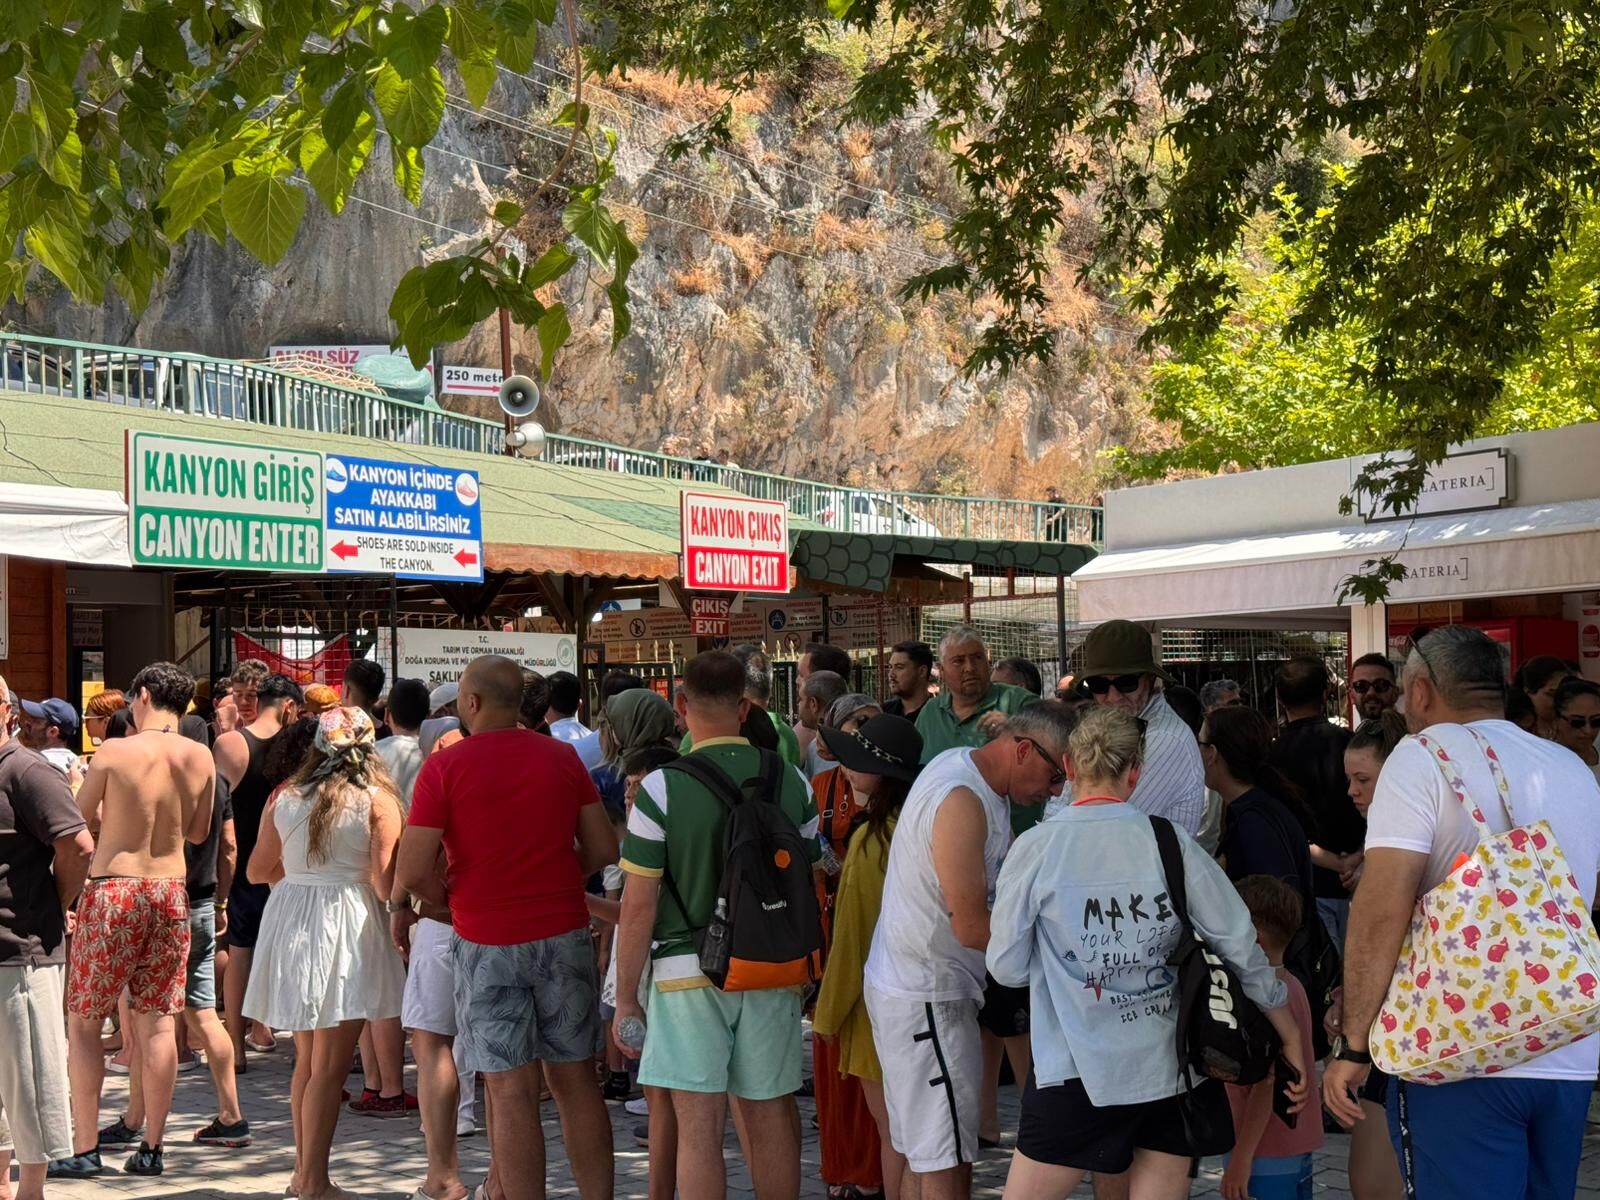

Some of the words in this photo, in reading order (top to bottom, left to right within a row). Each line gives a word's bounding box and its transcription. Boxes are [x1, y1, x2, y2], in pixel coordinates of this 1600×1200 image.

[446, 369, 469, 381] 250
[473, 371, 504, 383] metr
[144, 450, 246, 499] KANYON
[253, 453, 315, 514] GİRİŞ
[349, 464, 407, 487] KANYON
[409, 467, 454, 491] İÇİNDE
[370, 488, 437, 511] AYAKKABI
[334, 507, 376, 527] SATIN
[378, 510, 471, 534] ALABİLİRSİNİZ
[690, 505, 745, 539] KANYON
[748, 511, 781, 549] ÇIKIŞ
[139, 513, 242, 561] CANYON
[248, 520, 320, 565] ENTER
[356, 536, 385, 550] SHOES
[386, 538, 405, 551] ARE
[406, 540, 426, 553] SOLD
[428, 541, 454, 554] INSIDE
[380, 557, 397, 569] THE
[398, 558, 435, 572] CANYON.
[695, 551, 750, 586] CANYON
[751, 555, 780, 587] EXIT
[692, 599, 730, 618] ÇIKIŞ
[695, 620, 726, 635] EXIT
[442, 645, 461, 654] TARIM
[462, 646, 470, 655] VE
[470, 646, 493, 655] ORMAN
[493, 646, 525, 656] BAKANLIĞI
[404, 655, 423, 665] DOĞA
[423, 656, 450, 665] KORUMA
[450, 657, 460, 666] VE
[1083, 891, 1173, 932] MAKE
[1080, 930, 1127, 949] YOUR
[1102, 952, 1140, 967] FULL
[1148, 943, 1162, 957] OF
[1110, 995, 1133, 1006] BEST
[1120, 1010, 1139, 1024] ICE
